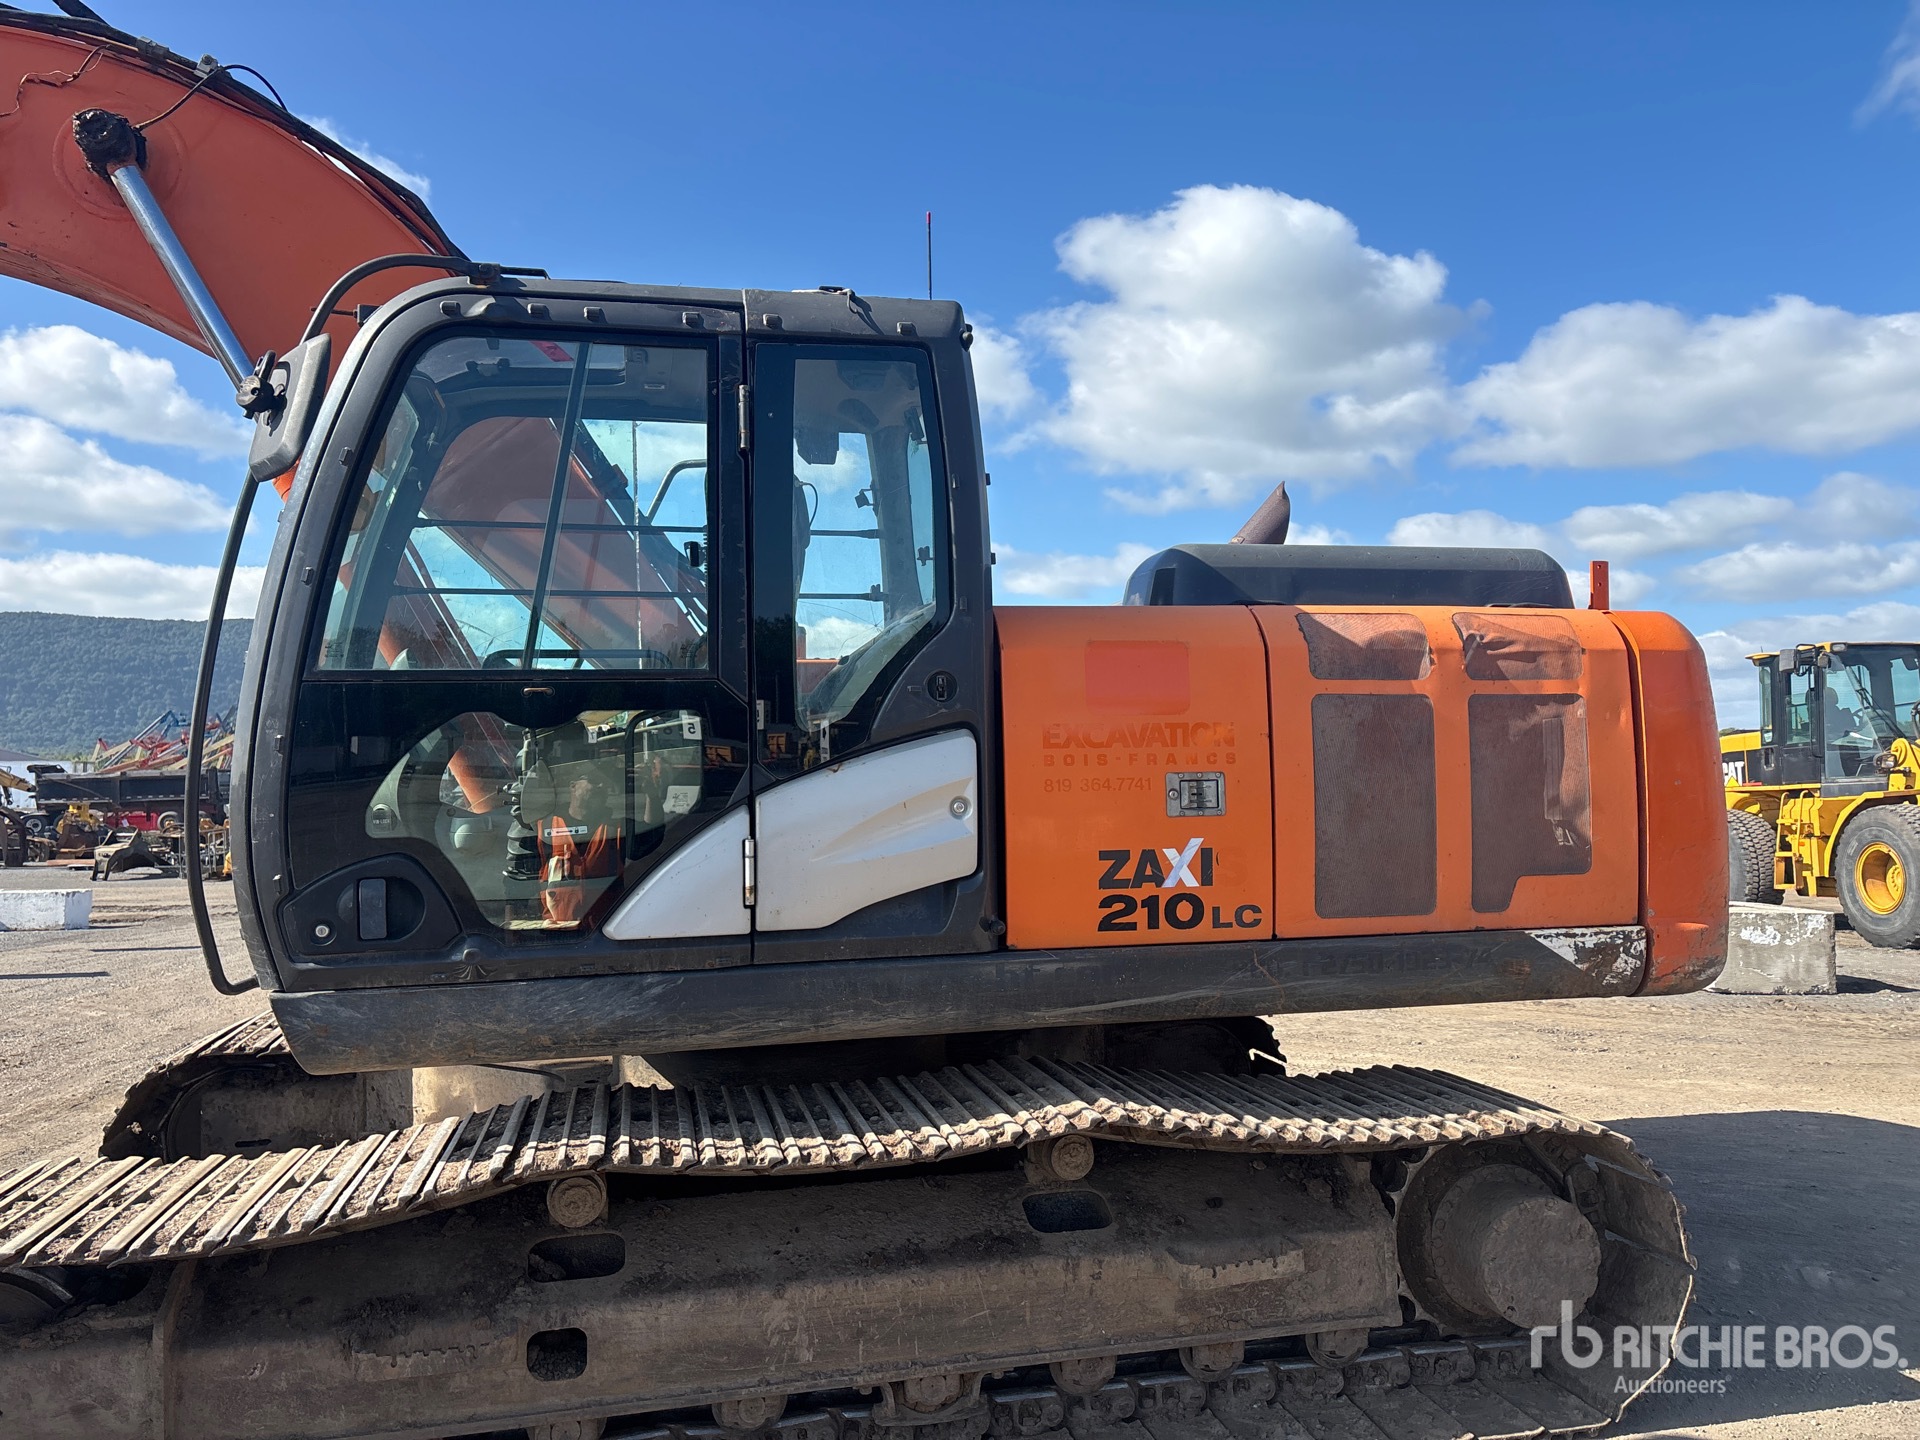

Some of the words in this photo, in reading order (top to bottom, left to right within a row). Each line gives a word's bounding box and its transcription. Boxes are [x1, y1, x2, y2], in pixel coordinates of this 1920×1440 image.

[1042, 722, 1235, 749] EXCAVATION
[1043, 778, 1072, 793] 819
[1080, 777, 1152, 792] 364.7741
[1097, 892, 1205, 931] 210
[1212, 904, 1262, 929] LC
